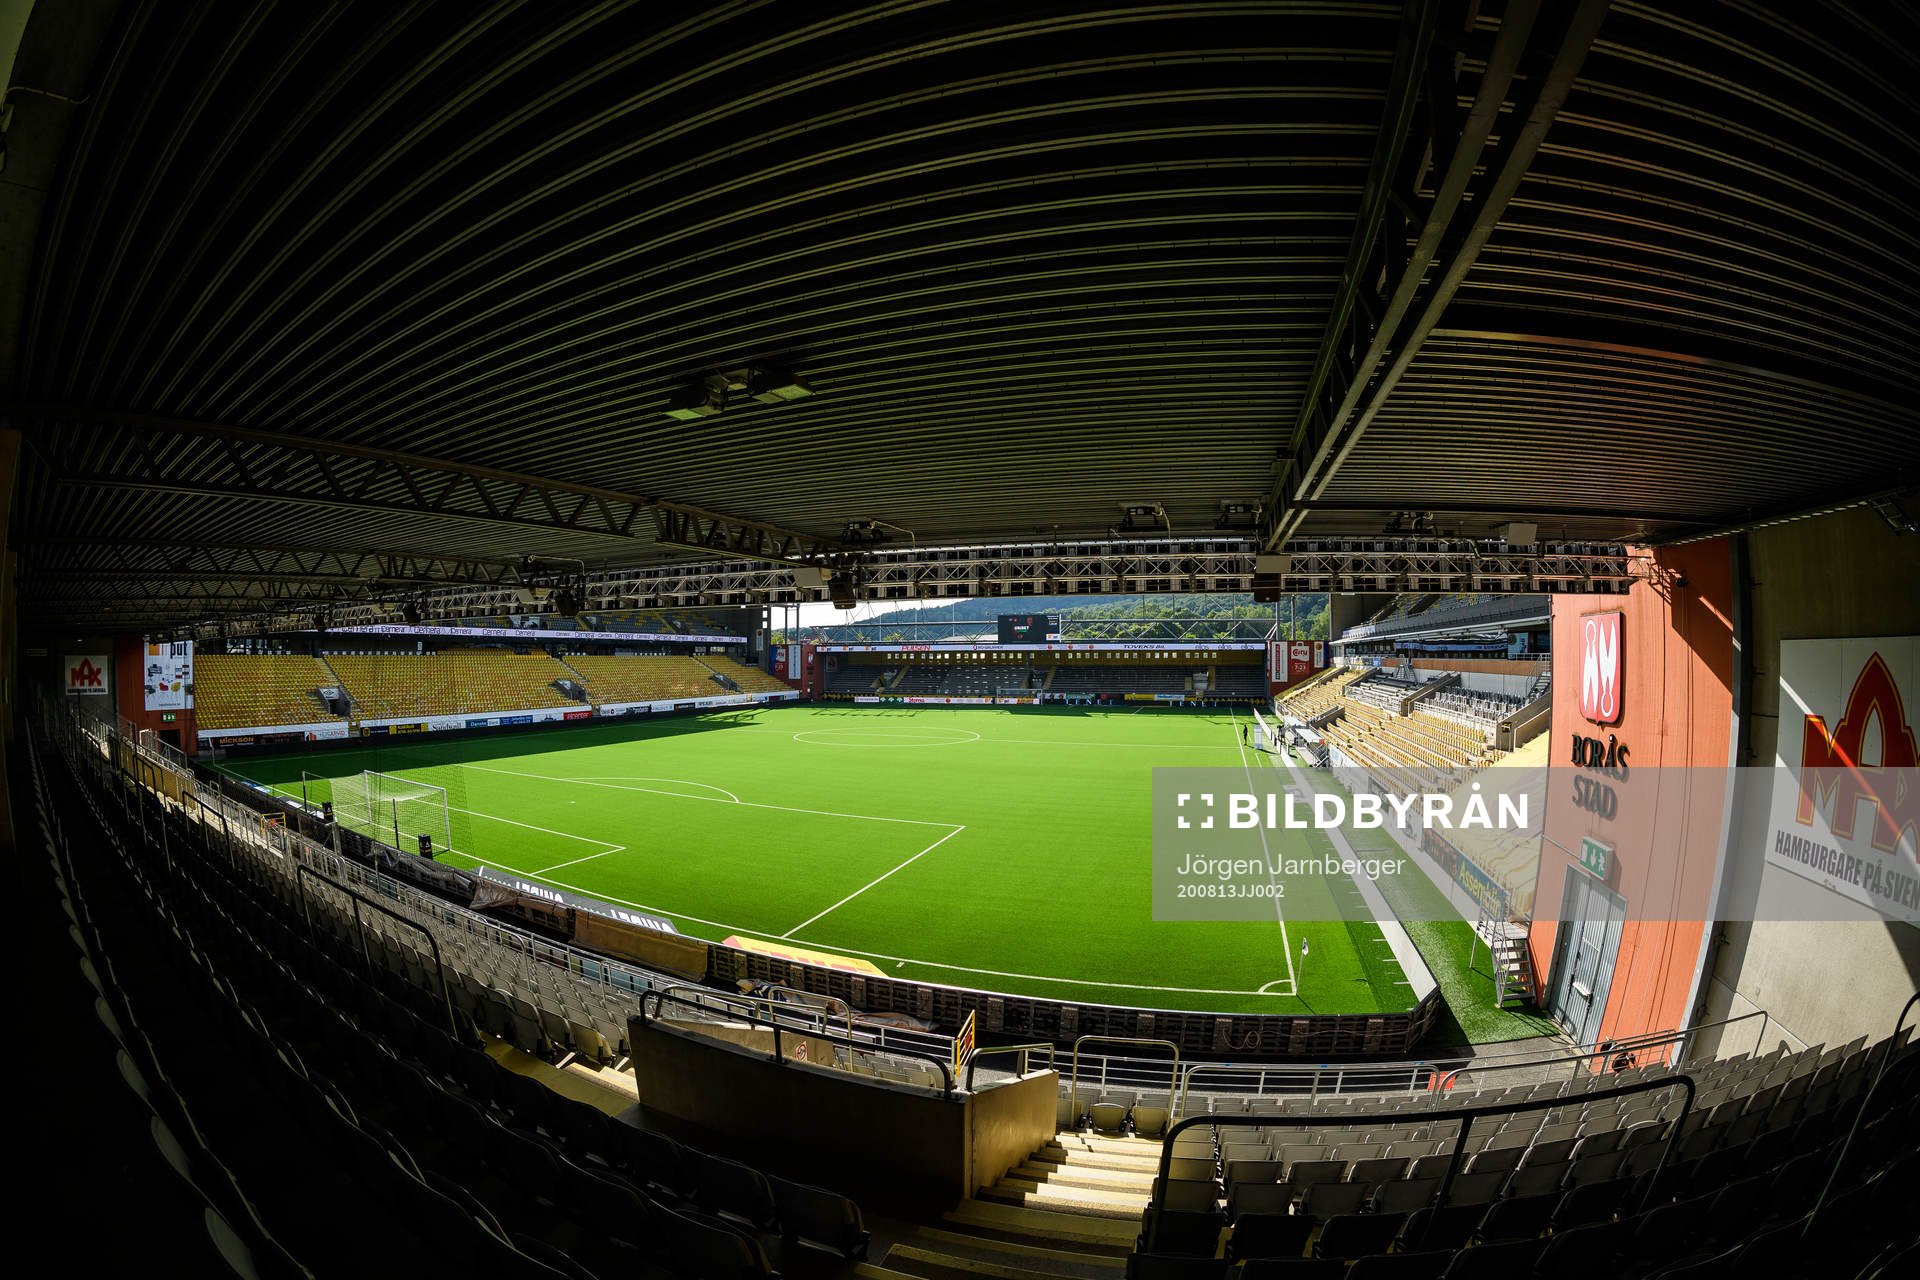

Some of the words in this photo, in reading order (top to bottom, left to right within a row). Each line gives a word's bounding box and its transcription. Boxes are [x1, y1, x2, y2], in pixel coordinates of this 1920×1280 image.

[70, 657, 102, 687] MAX
[1571, 734, 1630, 783] BORÅS
[1572, 774, 1618, 821] STAD
[1774, 829, 1861, 886] HAMBURGARE
